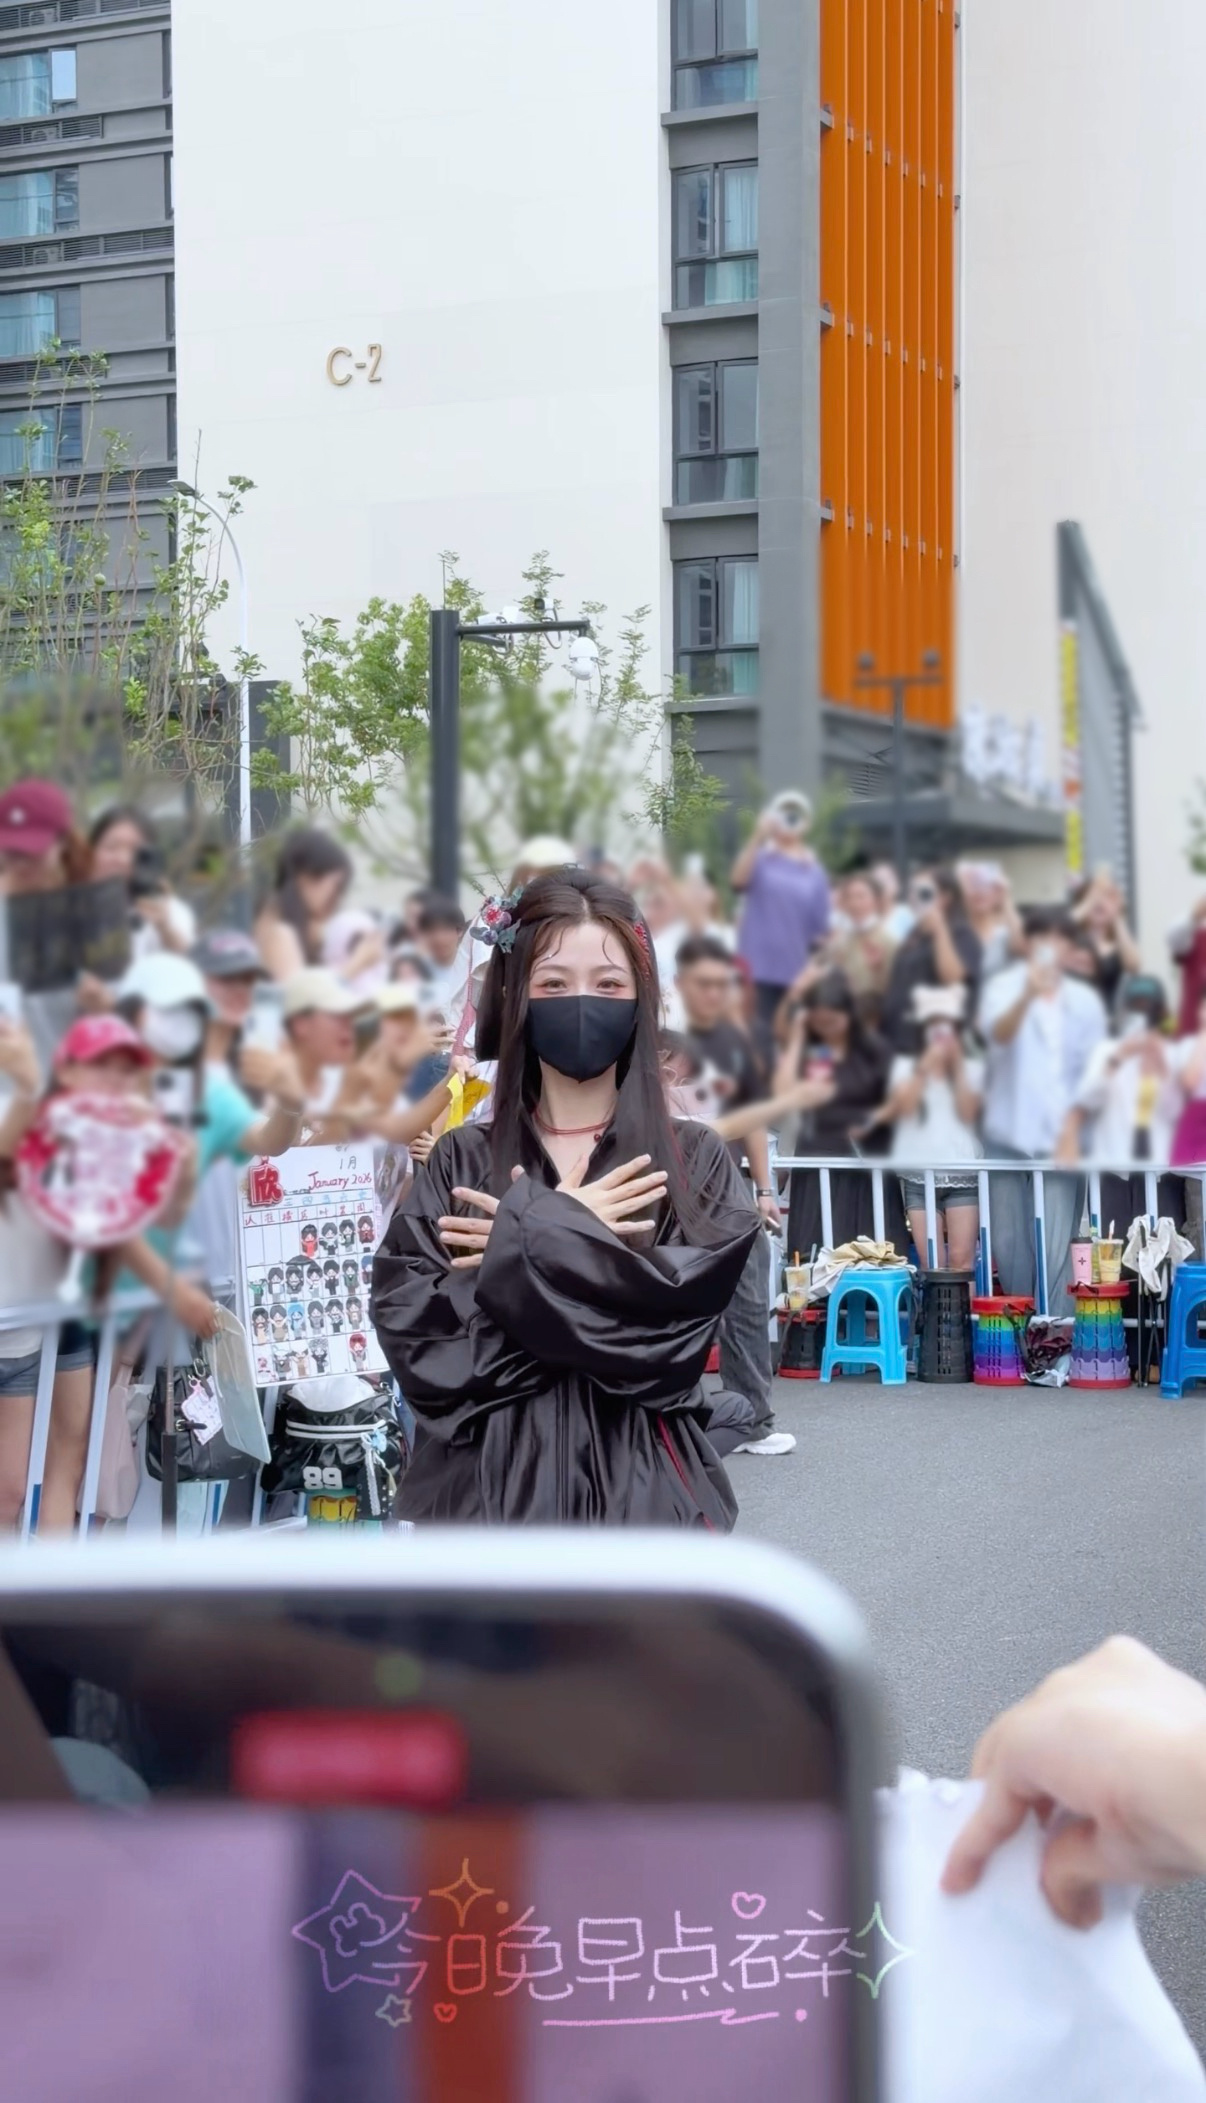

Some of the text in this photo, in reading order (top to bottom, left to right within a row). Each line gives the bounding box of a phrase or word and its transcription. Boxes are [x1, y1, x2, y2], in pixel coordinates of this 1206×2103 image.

[326, 343, 382, 386] C-2
[308, 1171, 372, 1190] January 2026
[303, 1466, 343, 1490] 89
